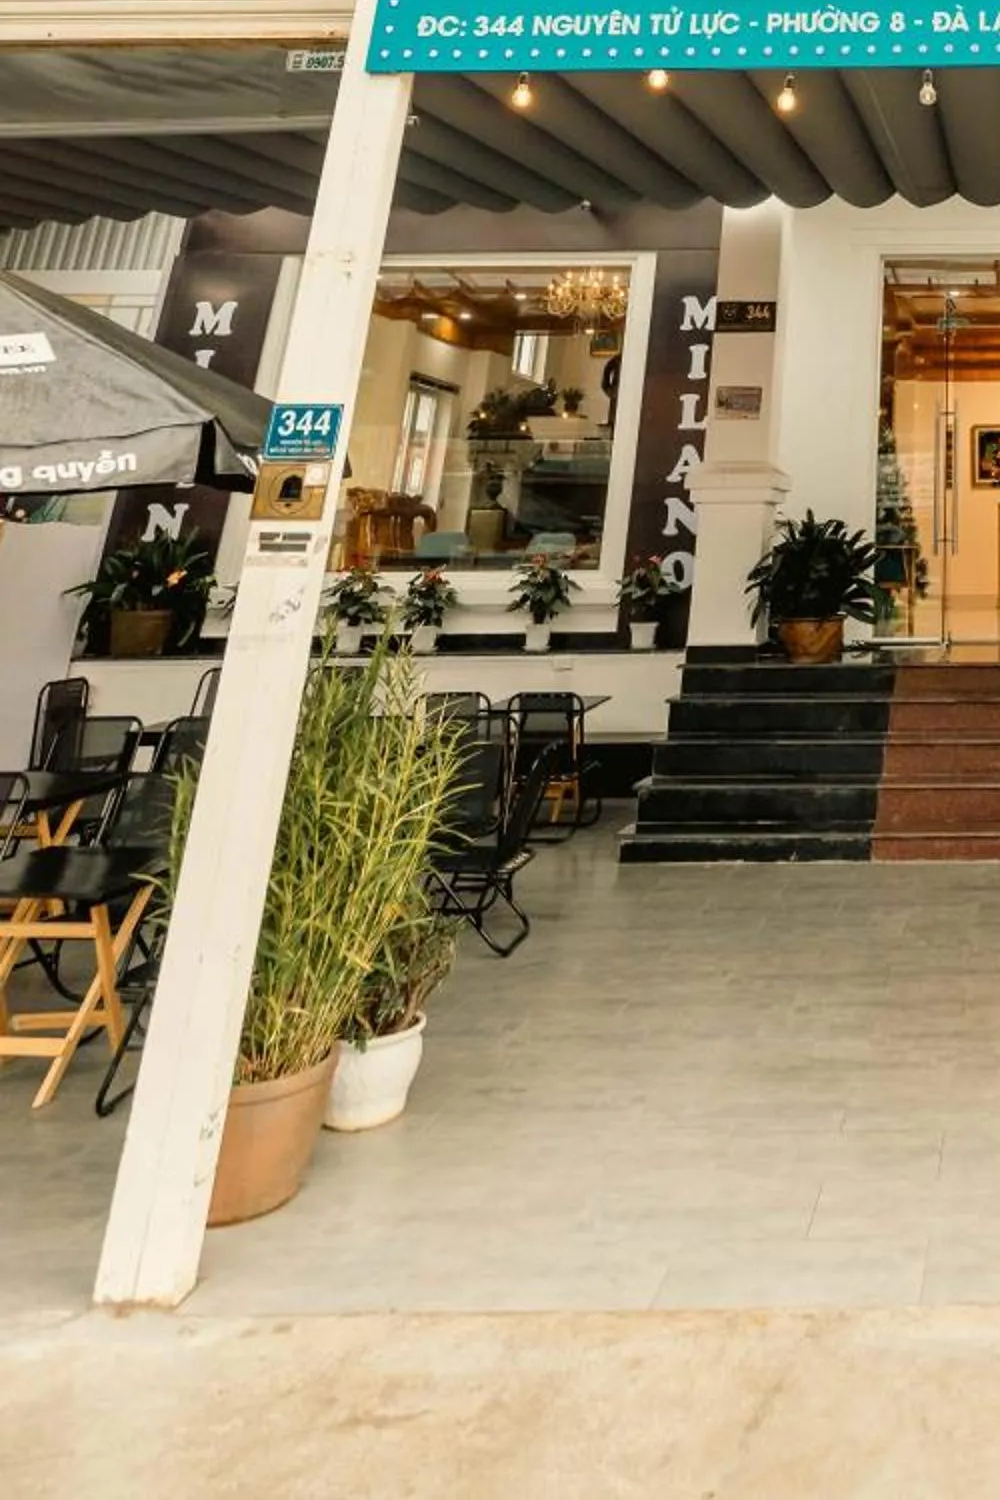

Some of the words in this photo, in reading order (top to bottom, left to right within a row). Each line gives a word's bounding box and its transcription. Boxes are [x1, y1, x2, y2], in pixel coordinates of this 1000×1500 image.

[417, 15, 467, 36] ĐC:
[473, 15, 525, 36] 344
[532, 10, 641, 36] NGUYÊN
[650, 5, 684, 35] TỬ
[689, 9, 742, 39] LỰC
[766, 4, 881, 33] PHƯỜNG
[889, 11, 906, 33] 8
[932, 9, 970, 32] ĐÀ
[278, 410, 332, 437] 344
